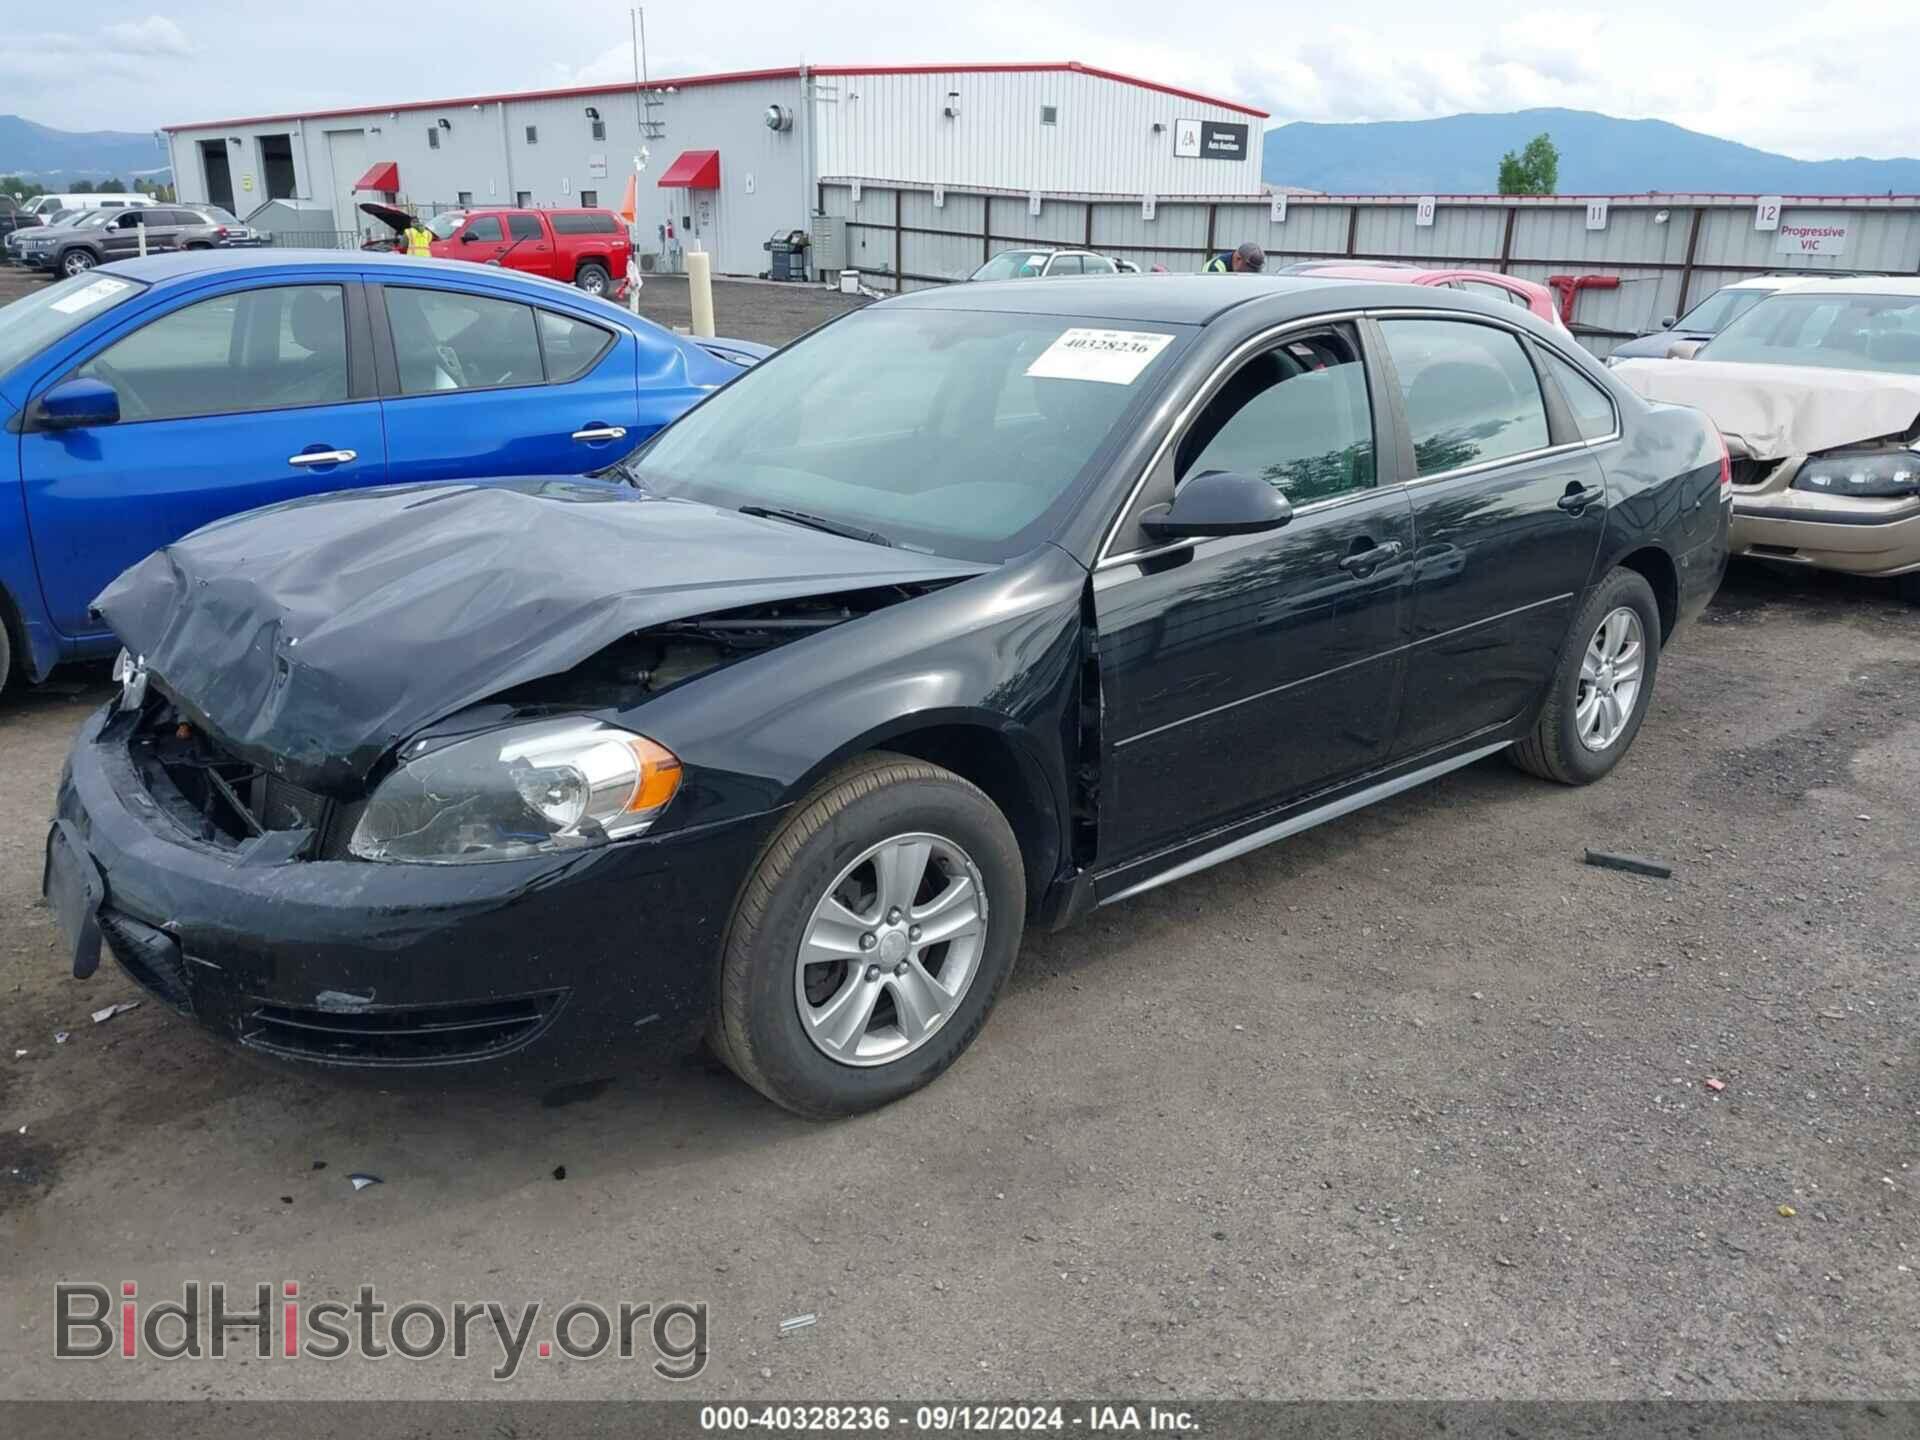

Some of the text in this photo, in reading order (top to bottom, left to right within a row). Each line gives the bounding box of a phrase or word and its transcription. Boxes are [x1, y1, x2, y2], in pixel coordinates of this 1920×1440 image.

[1276, 202, 1282, 213] 9
[1419, 204, 1432, 218] 10
[1591, 205, 1603, 220] 11
[1761, 206, 1776, 220] 12
[1781, 225, 1845, 238] Progressive
[1801, 240, 1820, 250] VIC
[1064, 338, 1149, 354] 40328236
